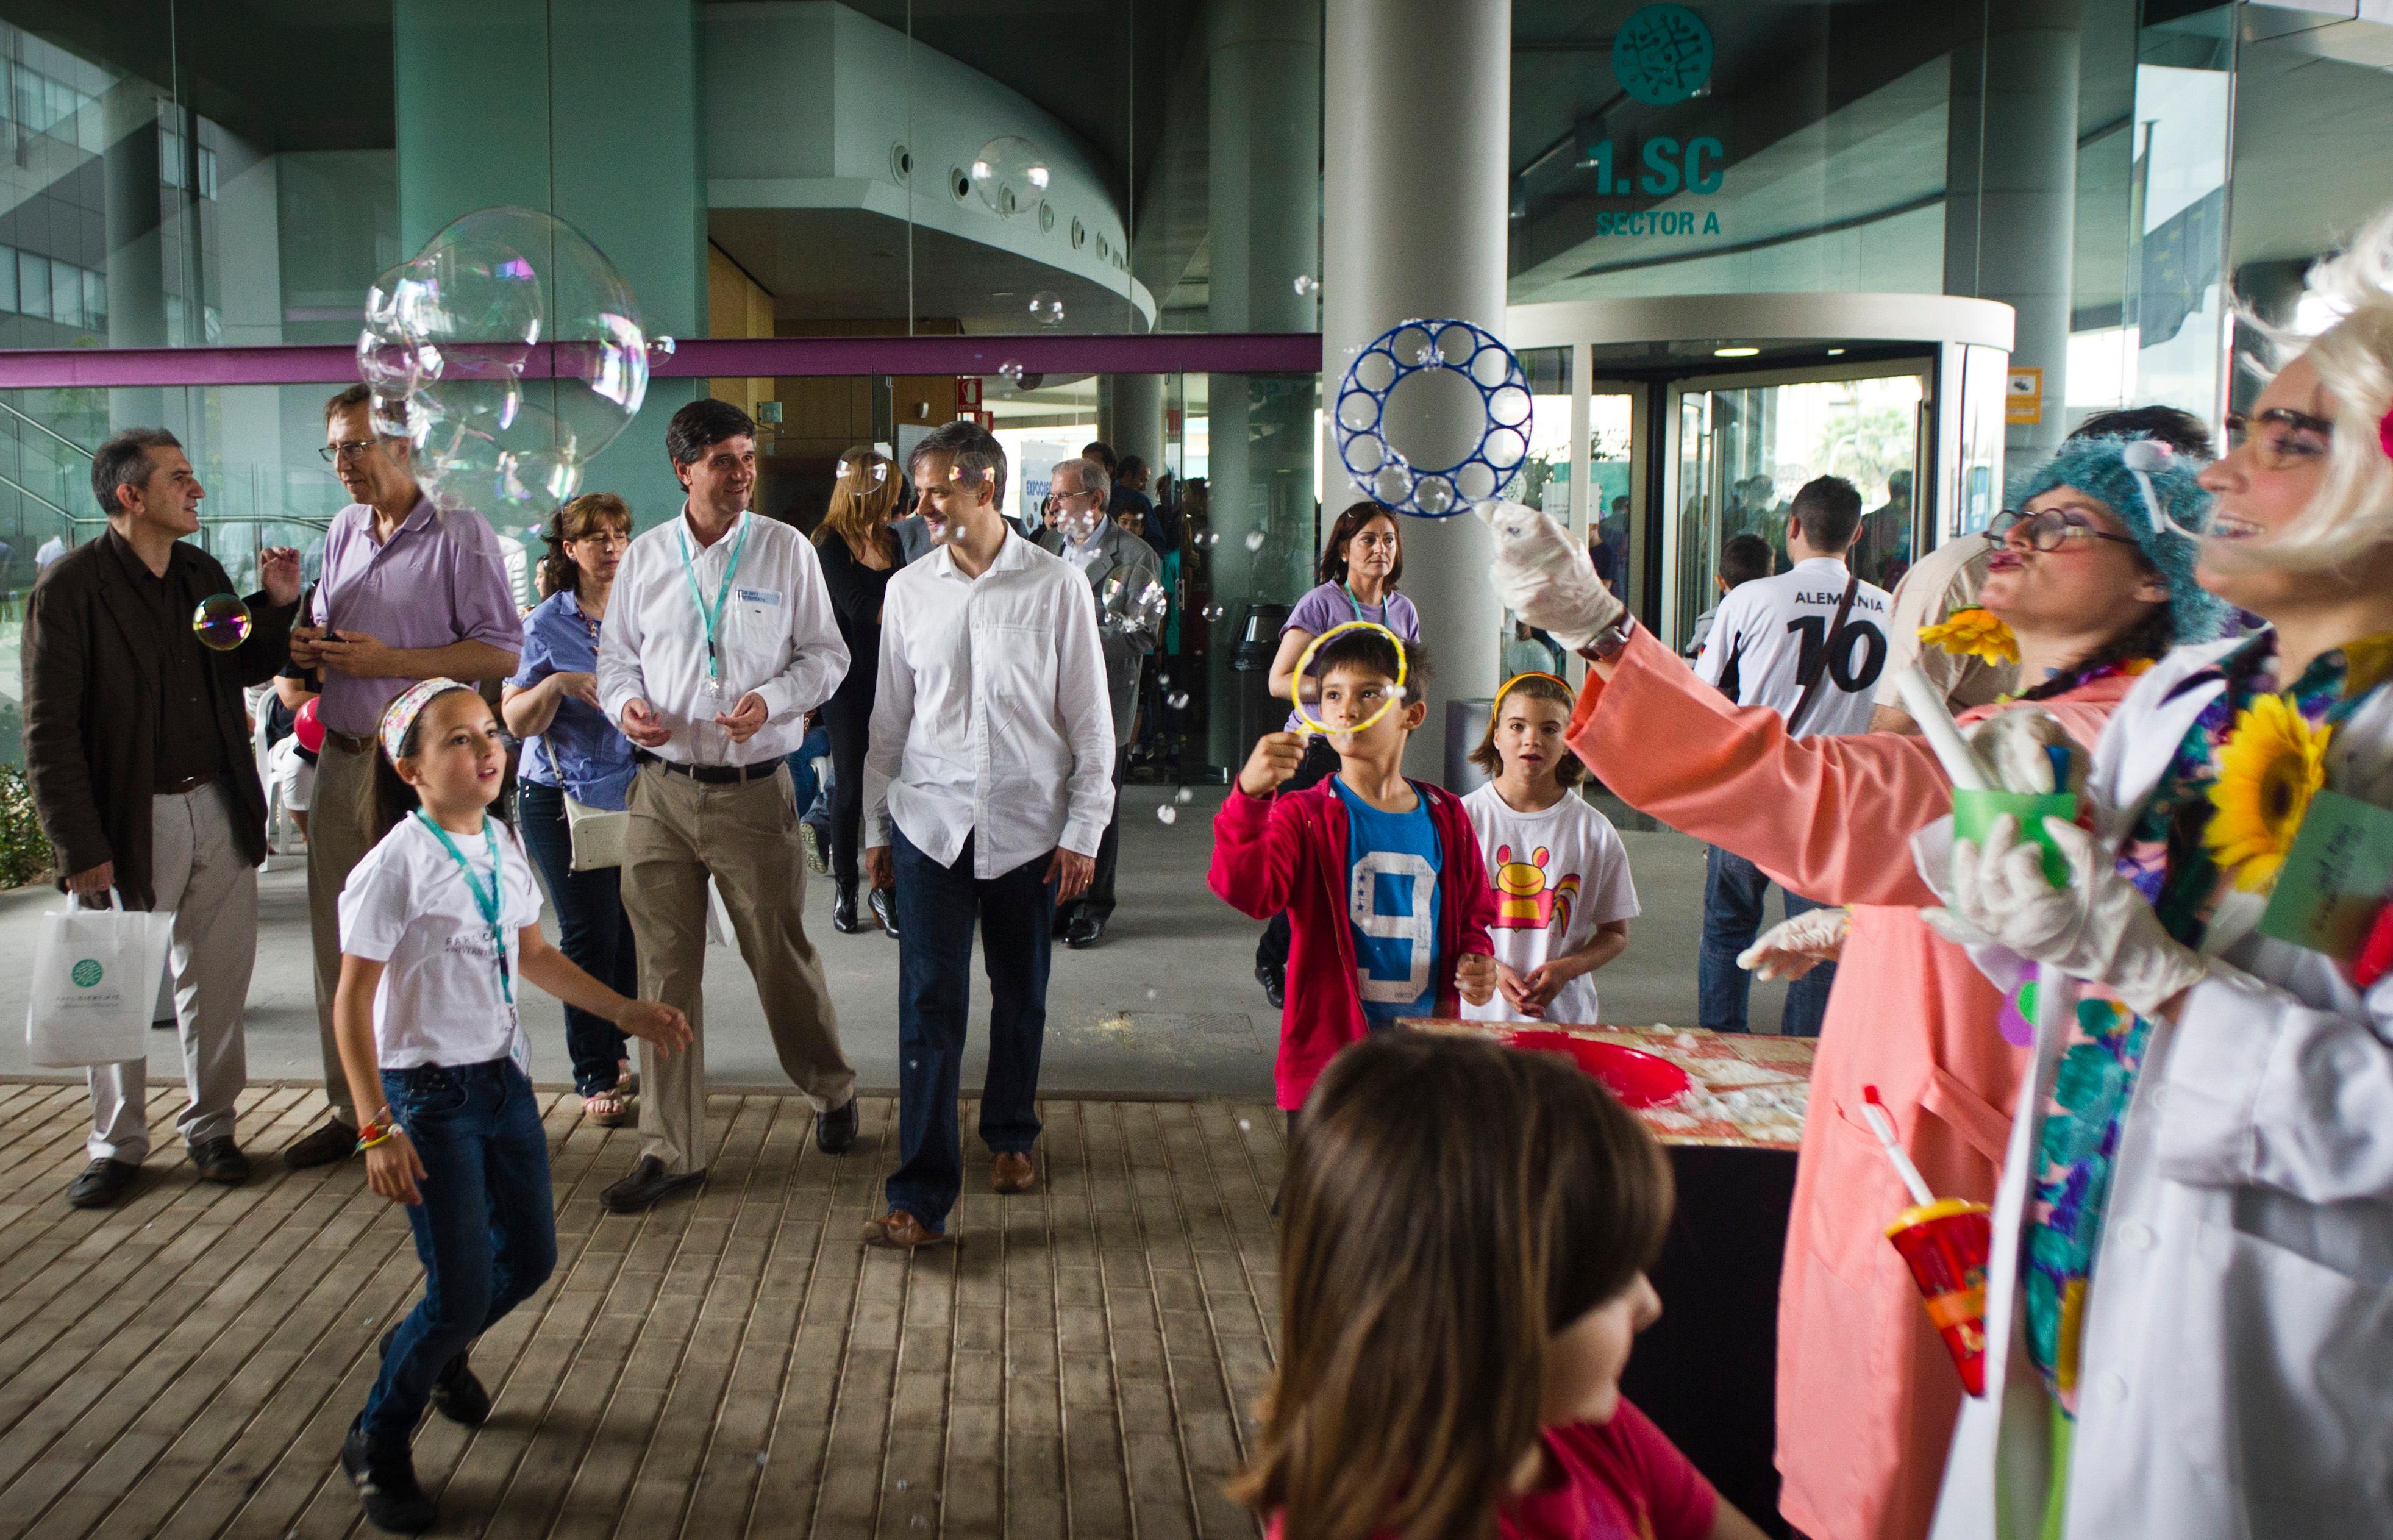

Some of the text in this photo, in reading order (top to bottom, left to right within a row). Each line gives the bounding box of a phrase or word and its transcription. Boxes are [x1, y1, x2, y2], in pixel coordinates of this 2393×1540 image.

[1588, 136, 1724, 196] 1.SC
[1596, 211, 1721, 235] SECTOR A
[1794, 591, 1883, 613] ALEMNIA
[1787, 615, 1887, 693] 10
[1350, 851, 1437, 1003] 9
